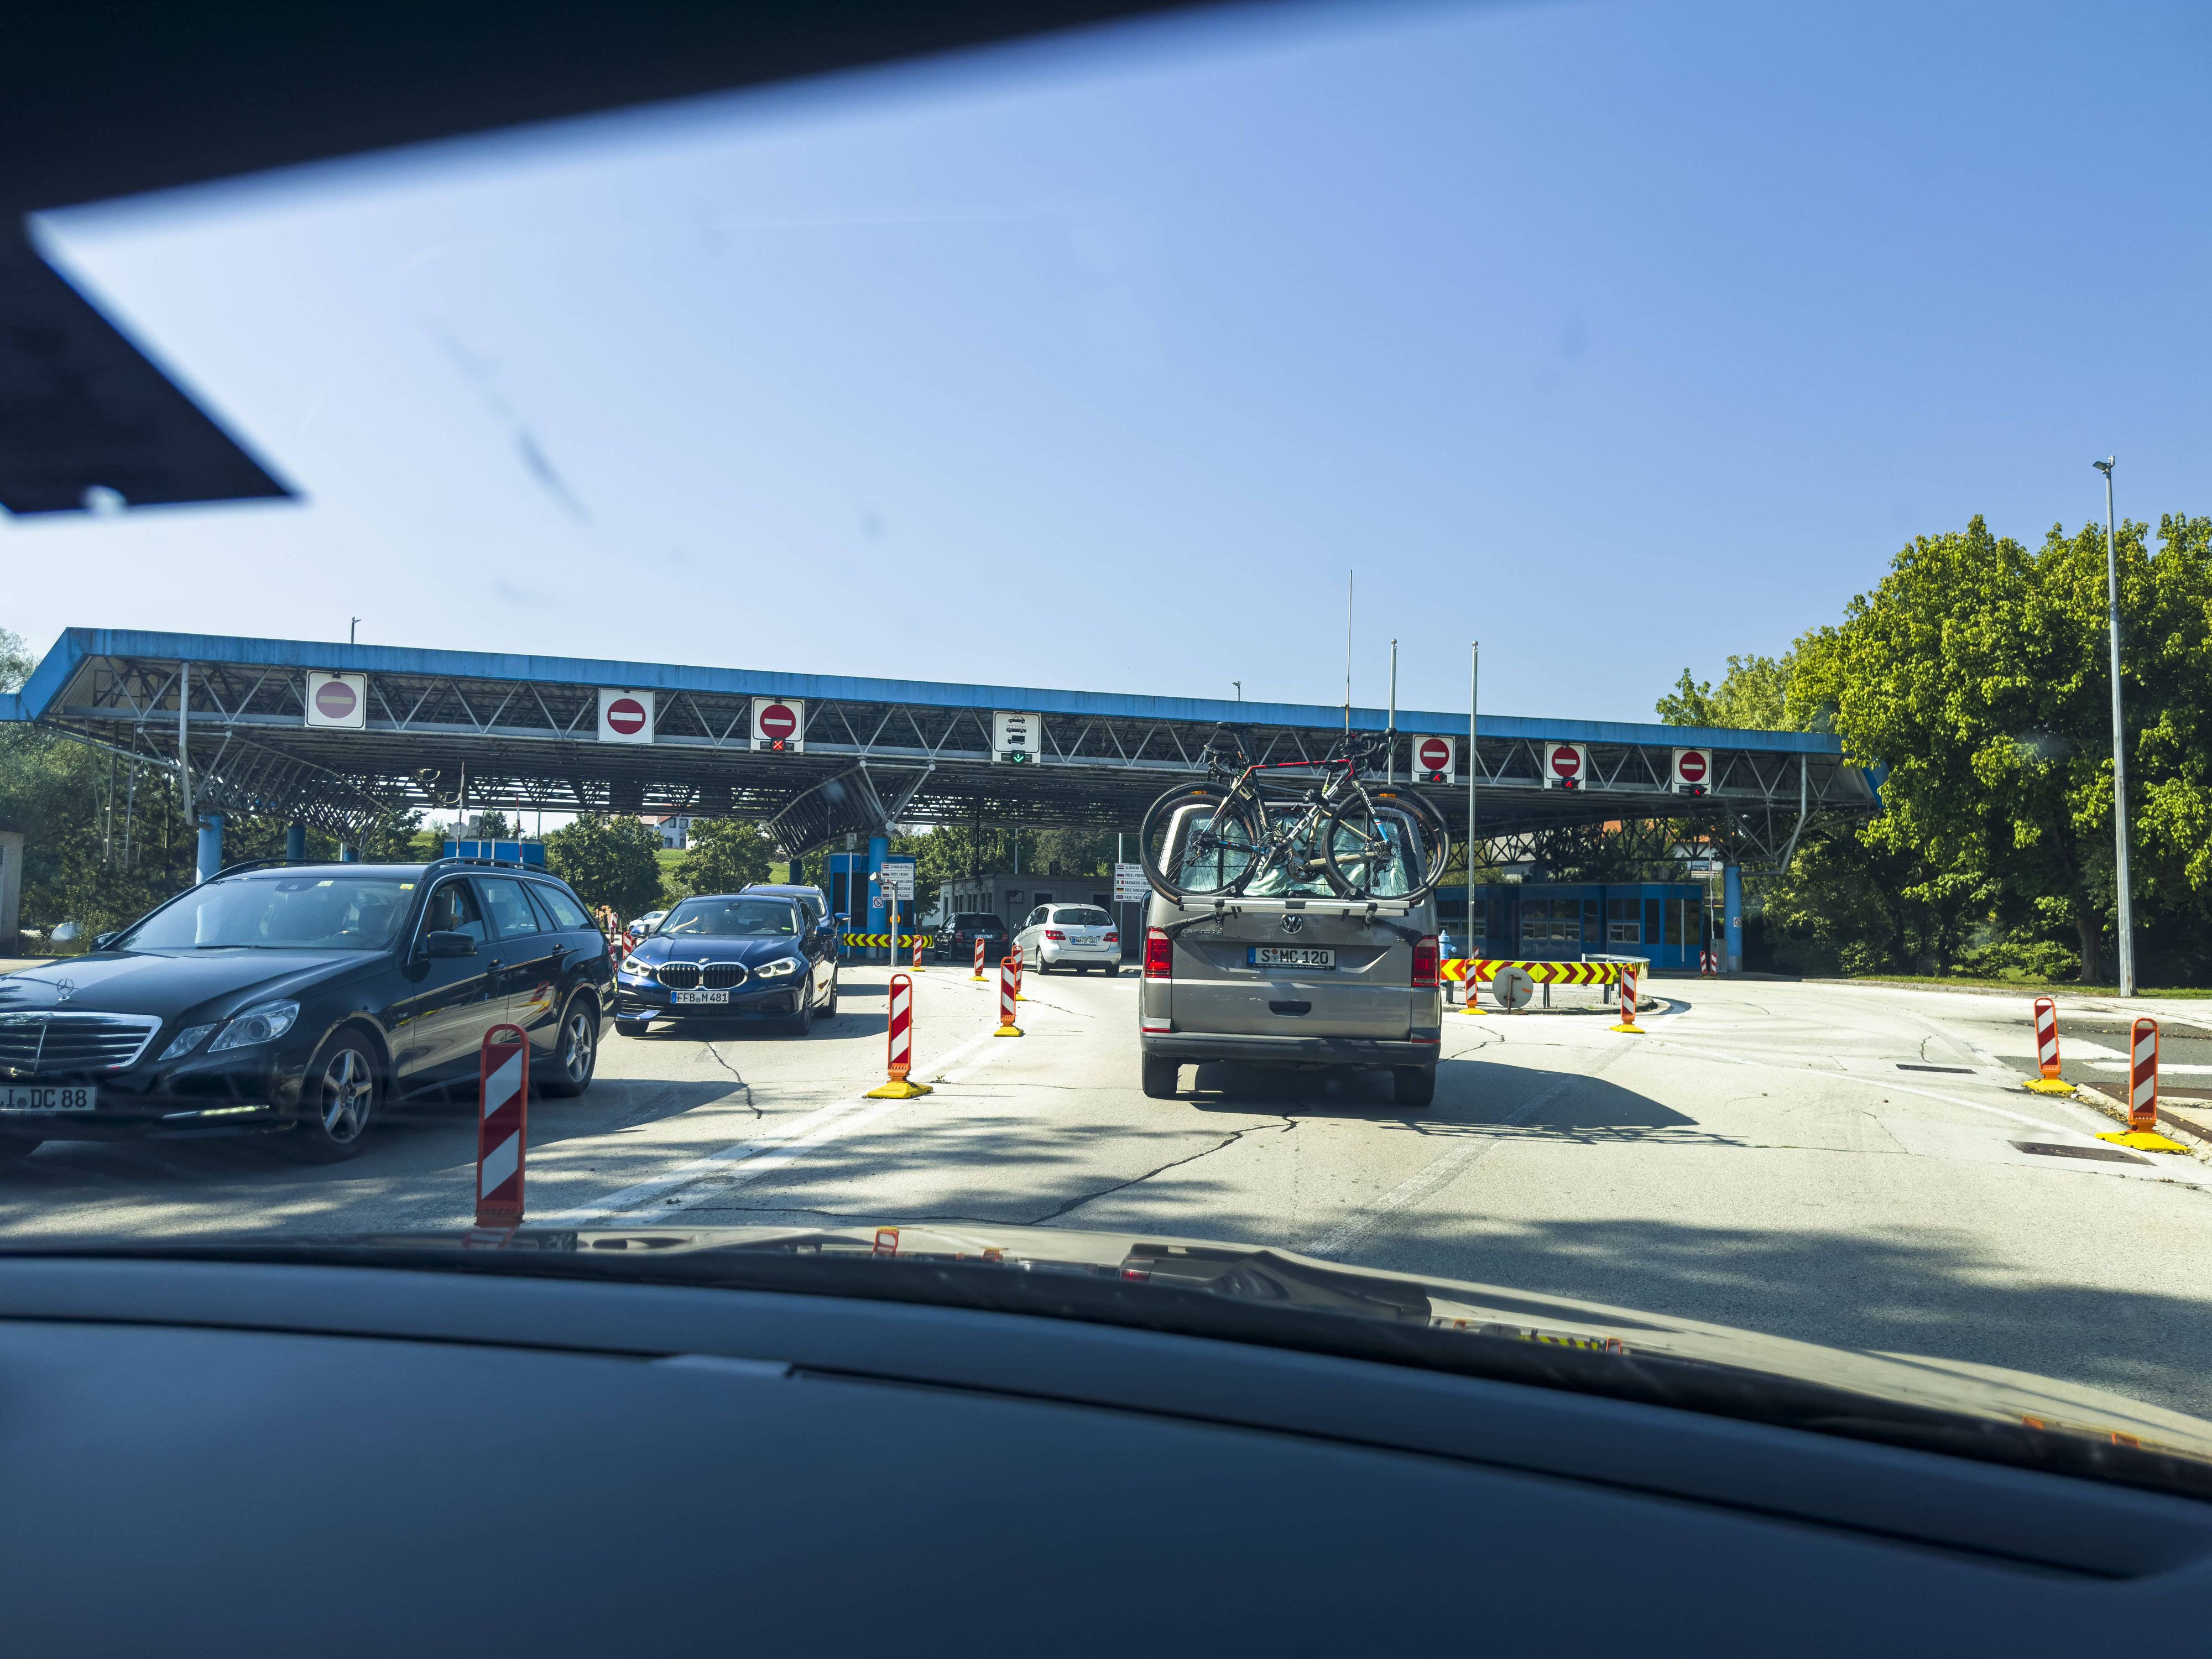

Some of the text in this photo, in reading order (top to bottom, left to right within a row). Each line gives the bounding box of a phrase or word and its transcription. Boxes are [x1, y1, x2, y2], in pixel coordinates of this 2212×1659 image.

[1359, 787, 1376, 815] FOCUS
[1261, 949, 1329, 964] S MC 120
[677, 993, 695, 1002] FFB
[702, 993, 708, 1002] M
[709, 993, 728, 1002] 481
[0, 1089, 87, 1108] I DC 88
